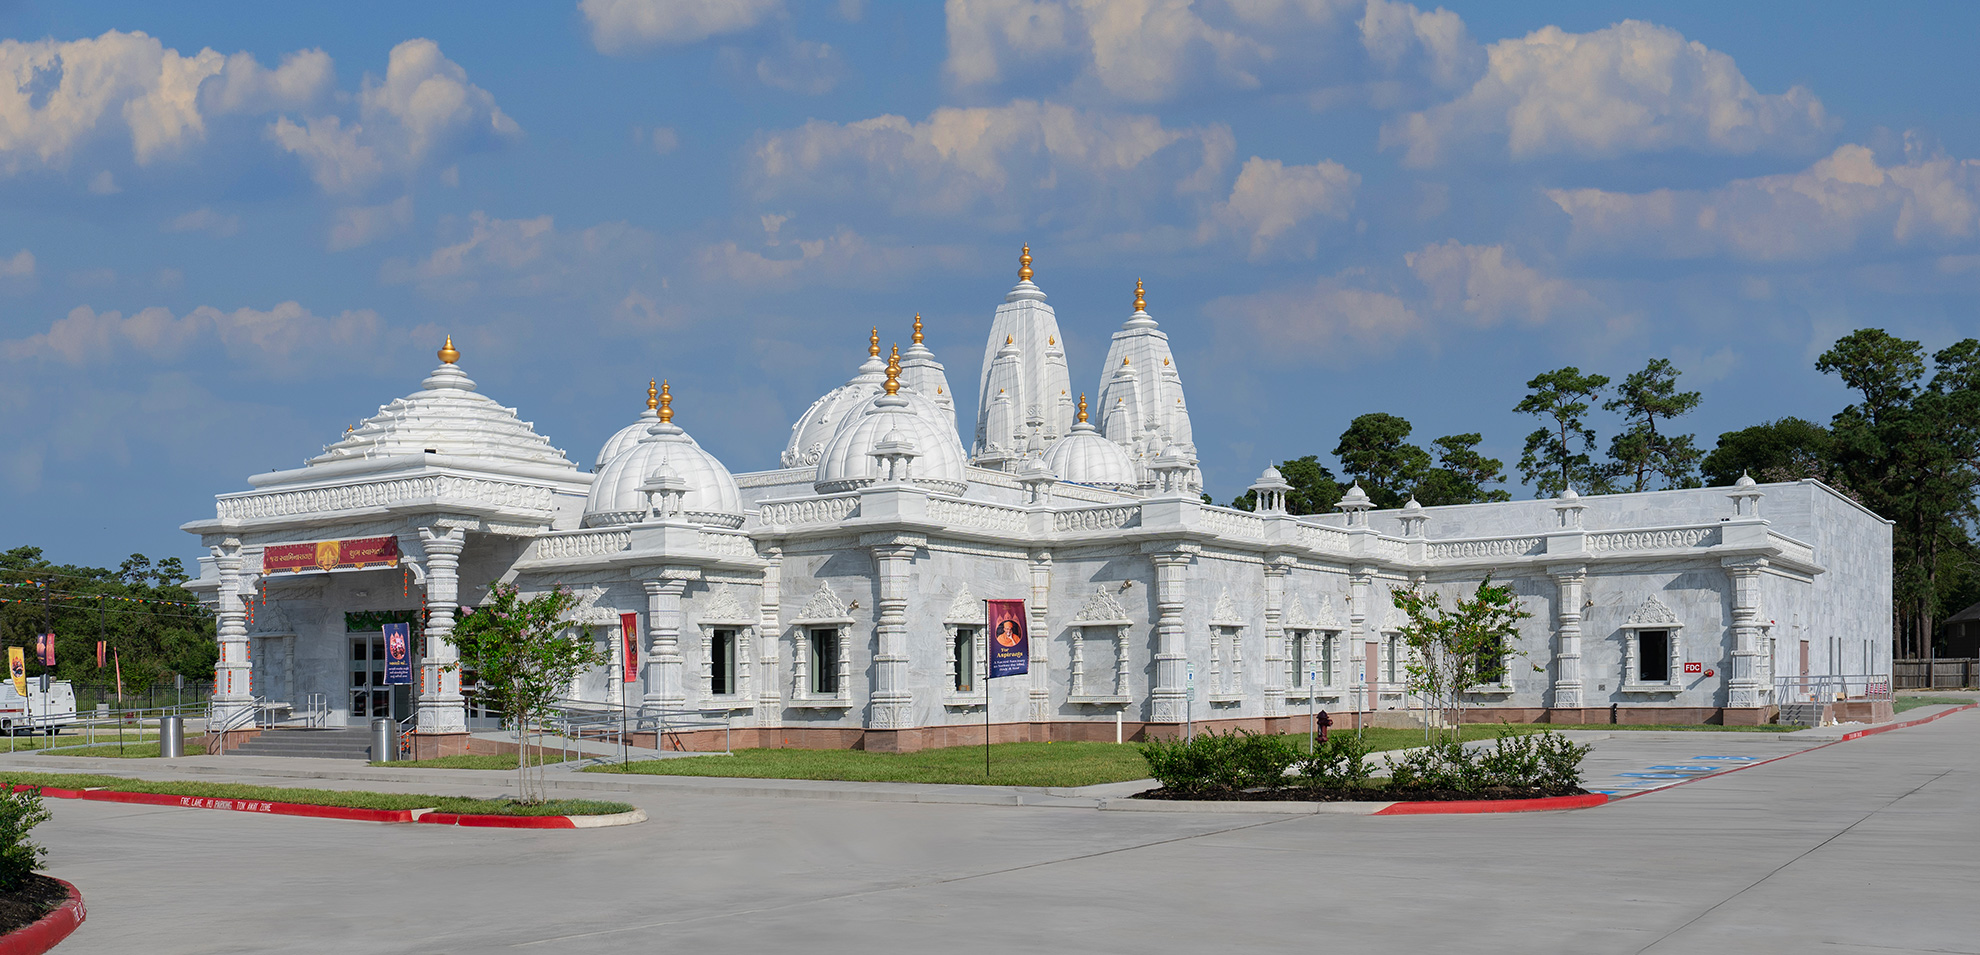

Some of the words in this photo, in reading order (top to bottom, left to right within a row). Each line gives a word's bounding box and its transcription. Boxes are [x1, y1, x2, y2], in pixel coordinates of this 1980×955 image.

[180, 797, 191, 806] FIRE
[191, 798, 204, 807] LANE
[206, 799, 214, 808] NO
[214, 801, 232, 810] PARKING
[236, 801, 246, 810] TOW
[246, 802, 259, 811] AWAY
[259, 803, 273, 812] ZONE
